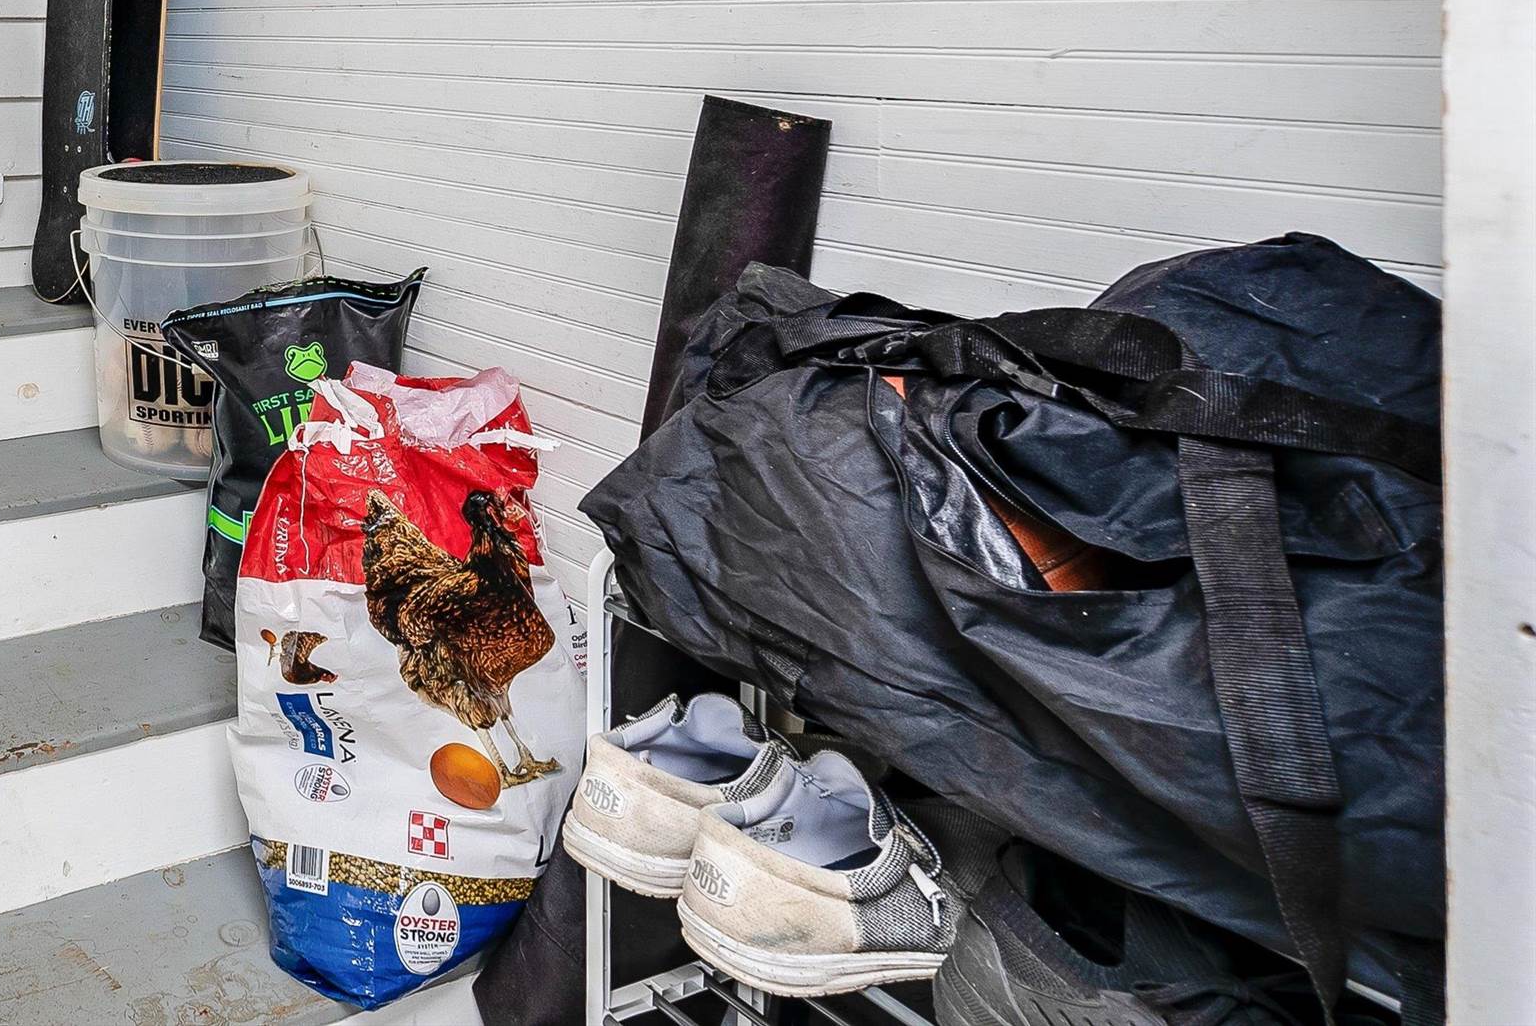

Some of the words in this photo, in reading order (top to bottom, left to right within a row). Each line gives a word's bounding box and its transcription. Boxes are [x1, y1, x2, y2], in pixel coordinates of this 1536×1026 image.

[186, 312, 205, 320] ZIPPER
[206, 310, 219, 318] SEAL
[220, 305, 250, 315] RECLOSABLE
[252, 392, 290, 414] FIRST
[274, 515, 290, 575] URINA
[310, 766, 326, 800] STRONG
[318, 767, 333, 802] OYSTER
[594, 778, 614, 796] HEY
[584, 778, 621, 813] DUDE
[692, 859, 731, 900] DUDE
[703, 859, 723, 881] HEY
[400, 915, 457, 931] OYSTER
[400, 927, 456, 943] STRONG
